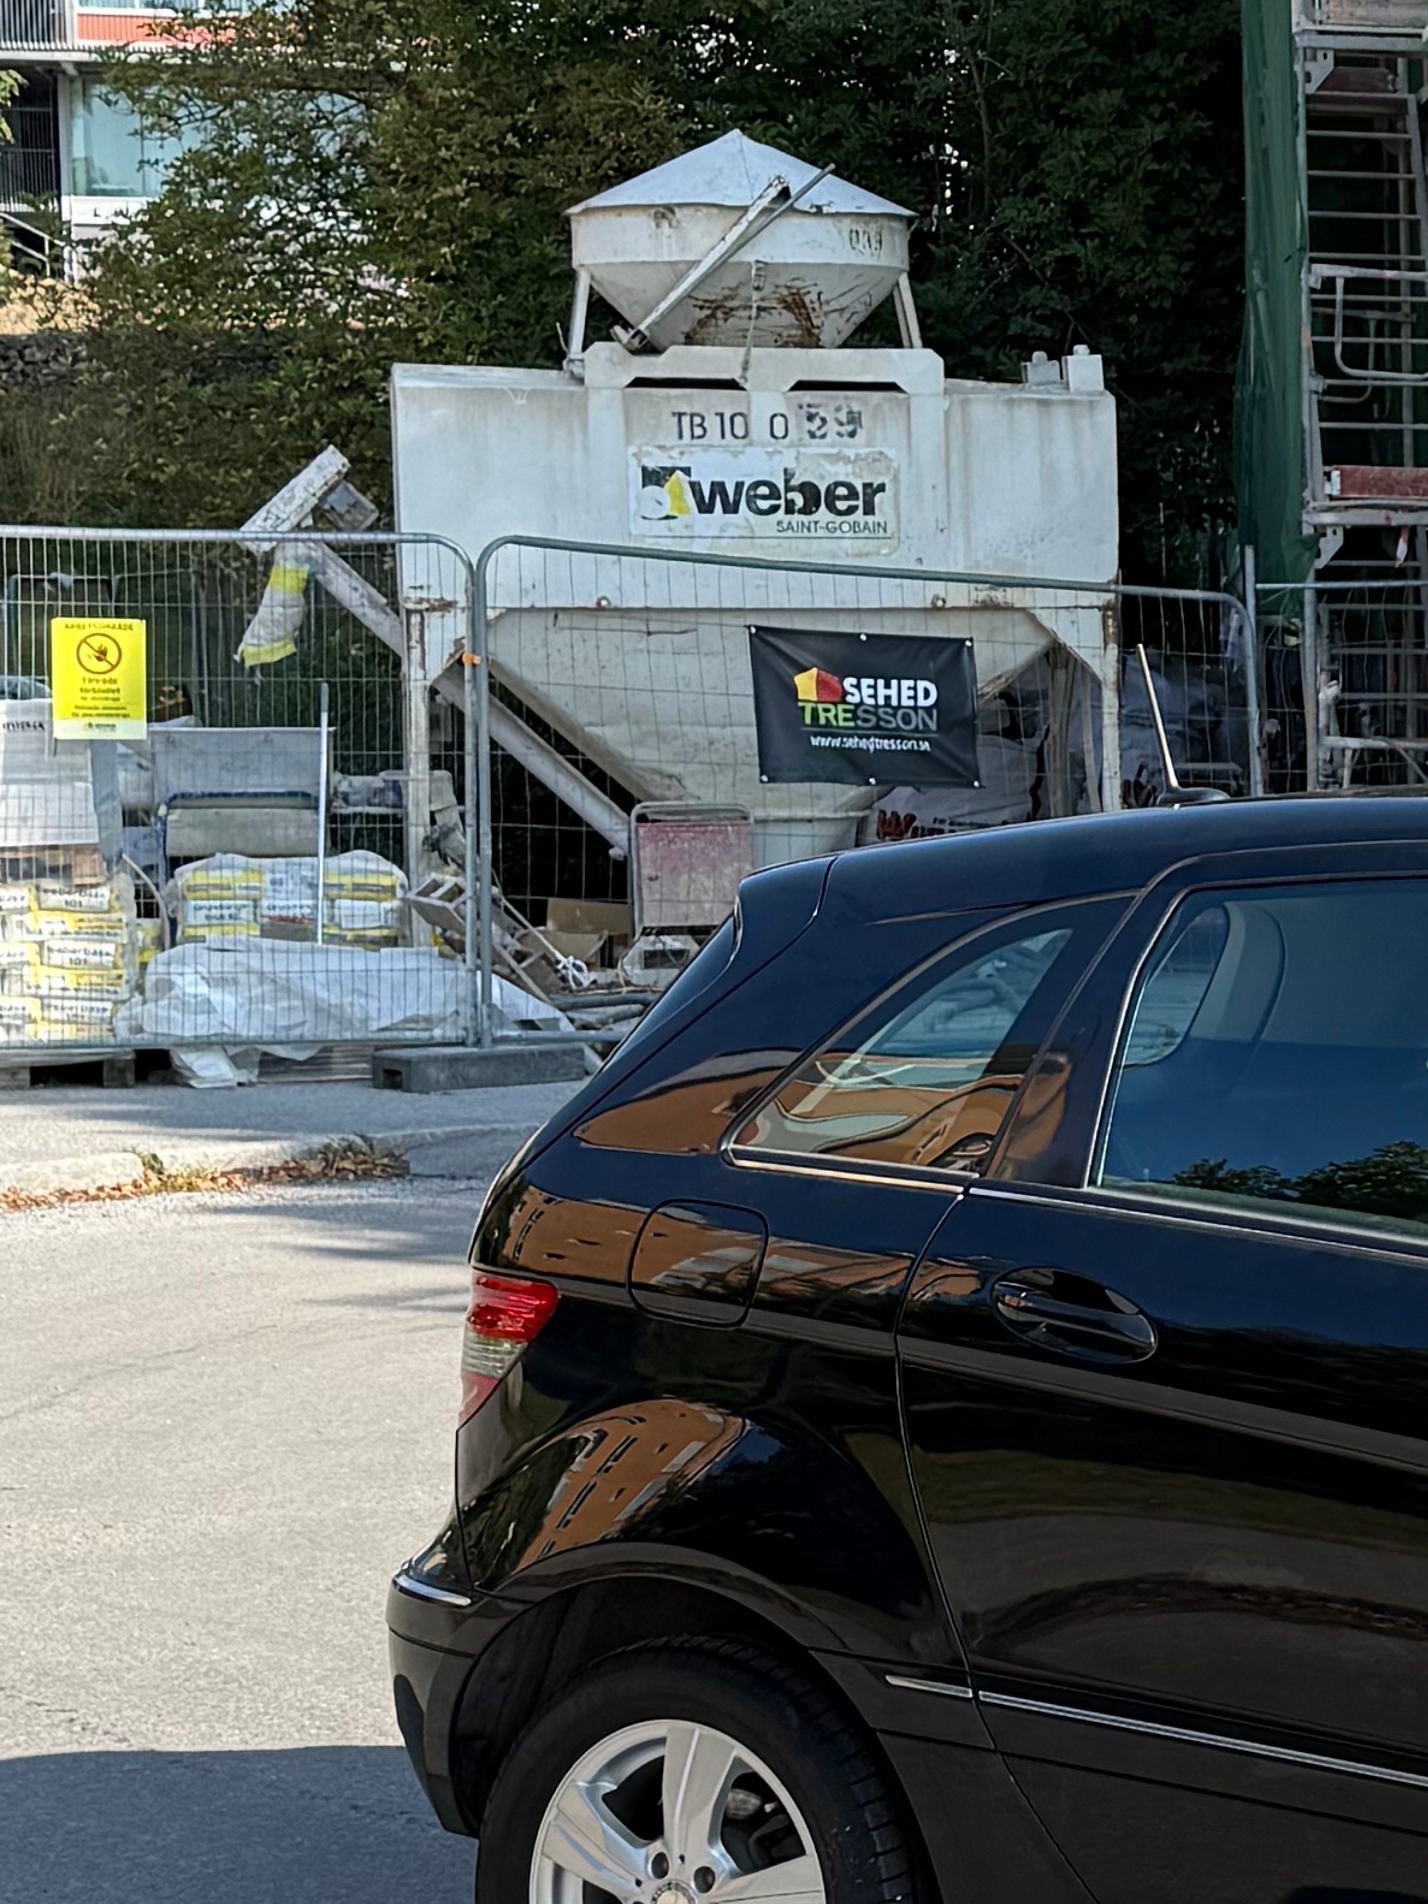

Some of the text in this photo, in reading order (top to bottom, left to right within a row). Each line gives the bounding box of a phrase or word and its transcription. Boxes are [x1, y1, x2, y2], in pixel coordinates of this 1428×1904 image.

[688, 467, 886, 516] weber
[776, 520, 888, 534] SAINT-GOBAIN
[842, 677, 938, 707] SEHED
[798, 701, 937, 731] TRESSON
